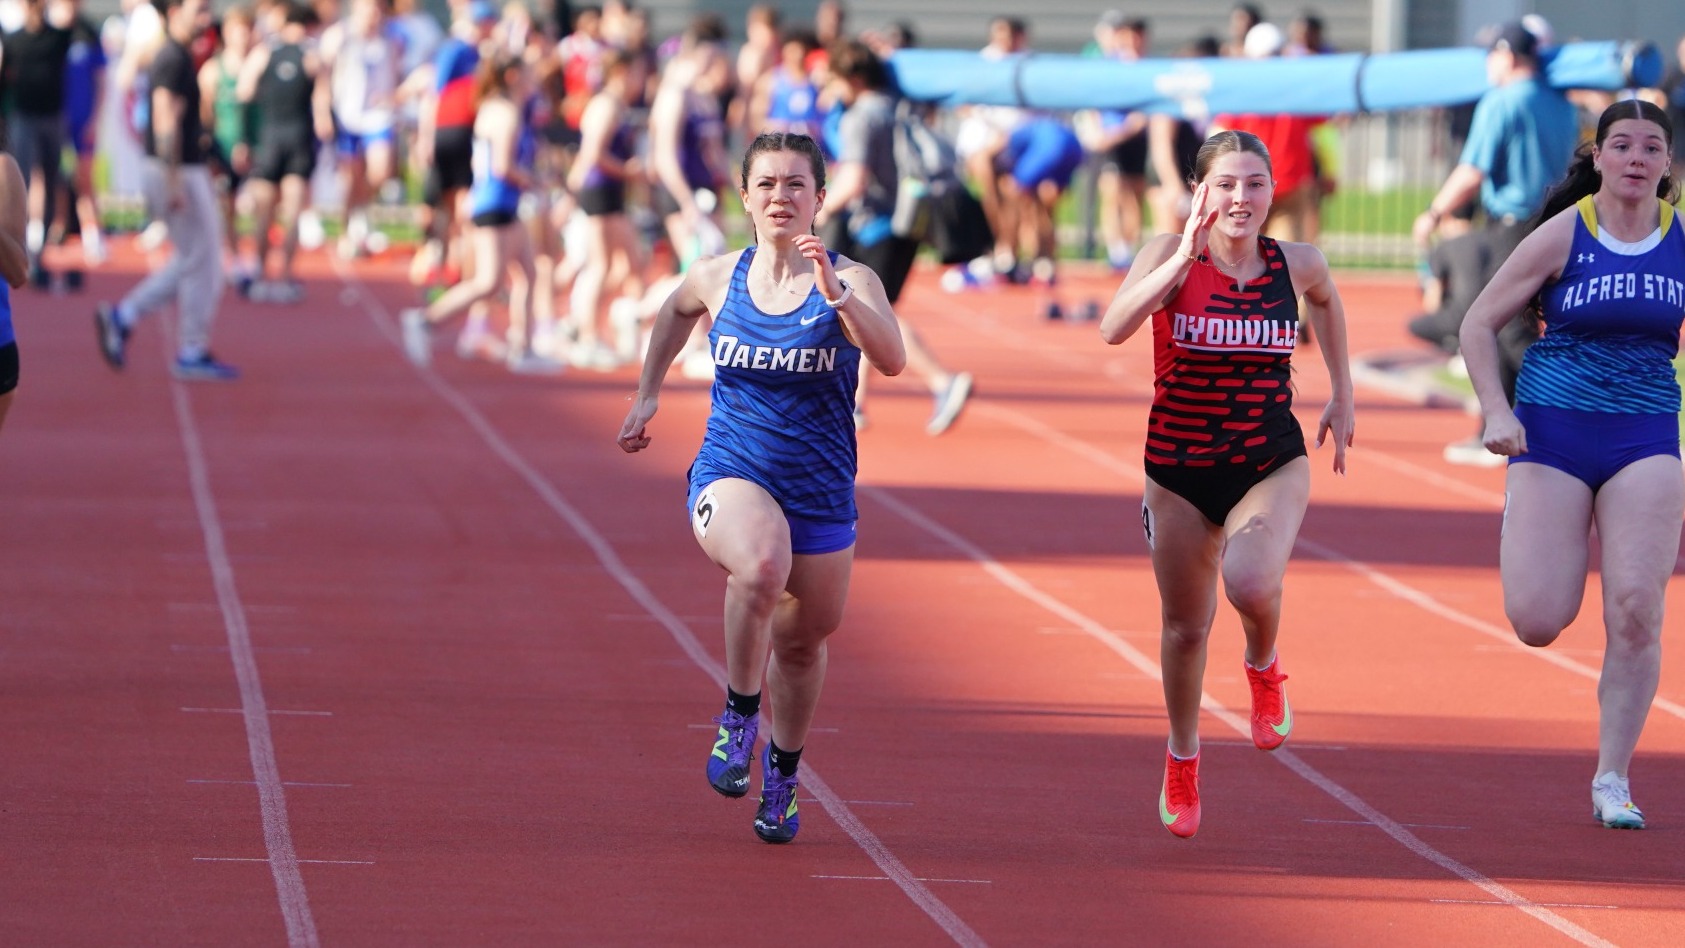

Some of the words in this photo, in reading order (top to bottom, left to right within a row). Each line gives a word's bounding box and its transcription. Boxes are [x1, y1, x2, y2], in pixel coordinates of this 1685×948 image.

[1562, 273, 1636, 312] ALFRED
[1643, 273, 1685, 313] STAT
[714, 334, 837, 373] DAEMEN
[697, 494, 713, 529] 5
